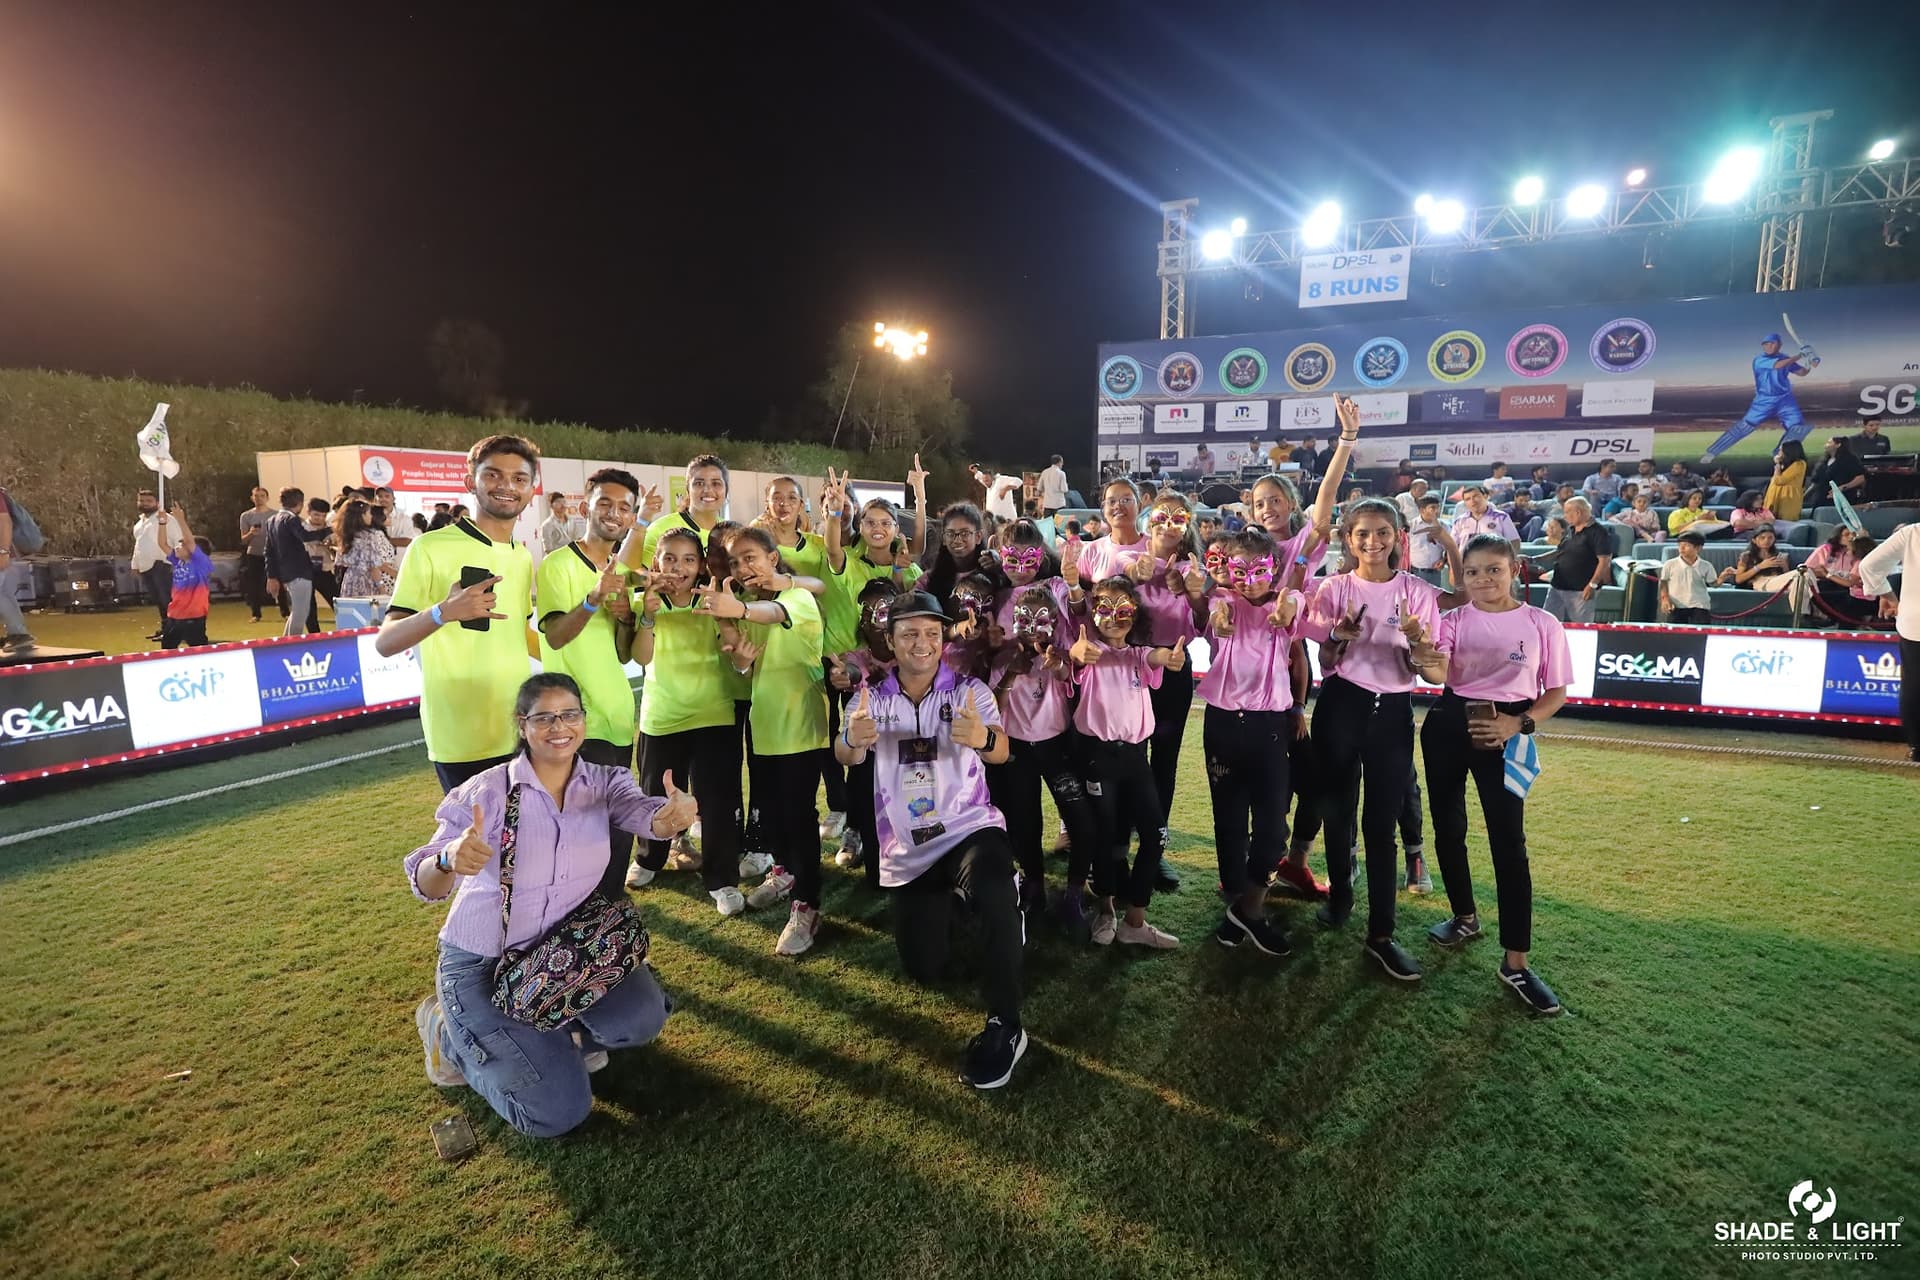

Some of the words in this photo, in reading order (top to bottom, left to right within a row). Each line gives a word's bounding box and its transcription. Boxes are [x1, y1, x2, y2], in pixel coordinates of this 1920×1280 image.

[1332, 254, 1377, 270] DPSL
[1308, 281, 1322, 298] 8
[1330, 275, 1400, 297] RUNS
[1569, 438, 1641, 456] DPSL
[261, 675, 358, 699] BHADEWALA
